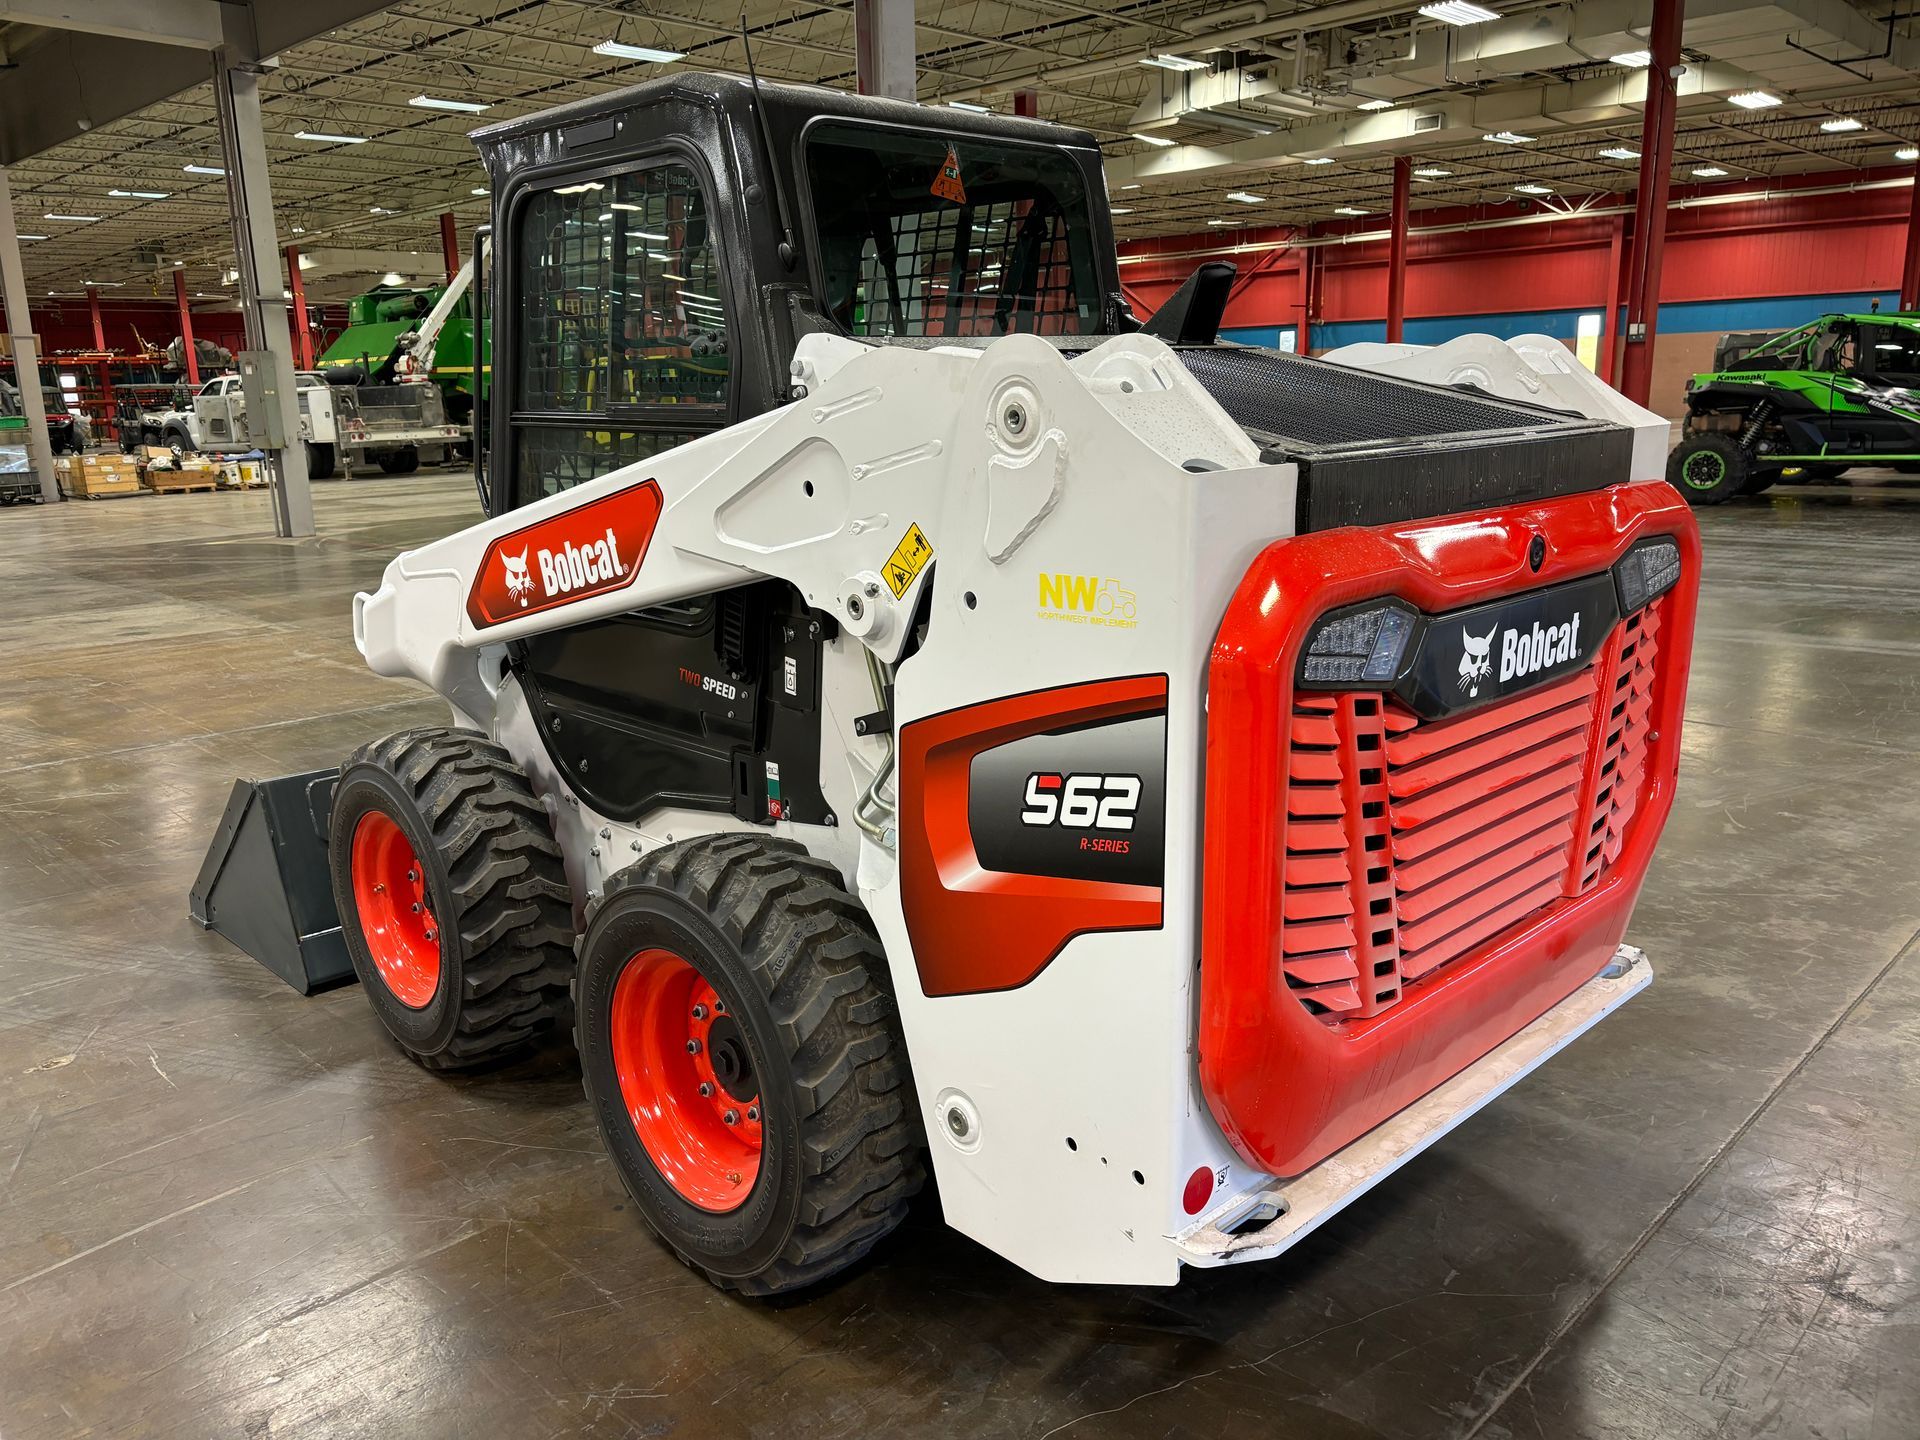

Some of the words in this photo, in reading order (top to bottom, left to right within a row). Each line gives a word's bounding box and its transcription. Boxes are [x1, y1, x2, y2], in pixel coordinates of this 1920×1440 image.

[1716, 373, 1767, 382] Kawasaki
[537, 527, 624, 597] Bobcat
[1038, 573, 1098, 613] NW
[1037, 610, 1088, 625] NORTHWEST
[1090, 616, 1138, 629] IMPLEMENT
[1499, 611, 1579, 683] Bobcat
[679, 667, 701, 687] TWO
[702, 677, 736, 701] SPEED
[1021, 772, 1142, 831] S62
[1079, 837, 1130, 854] R-SERIES
